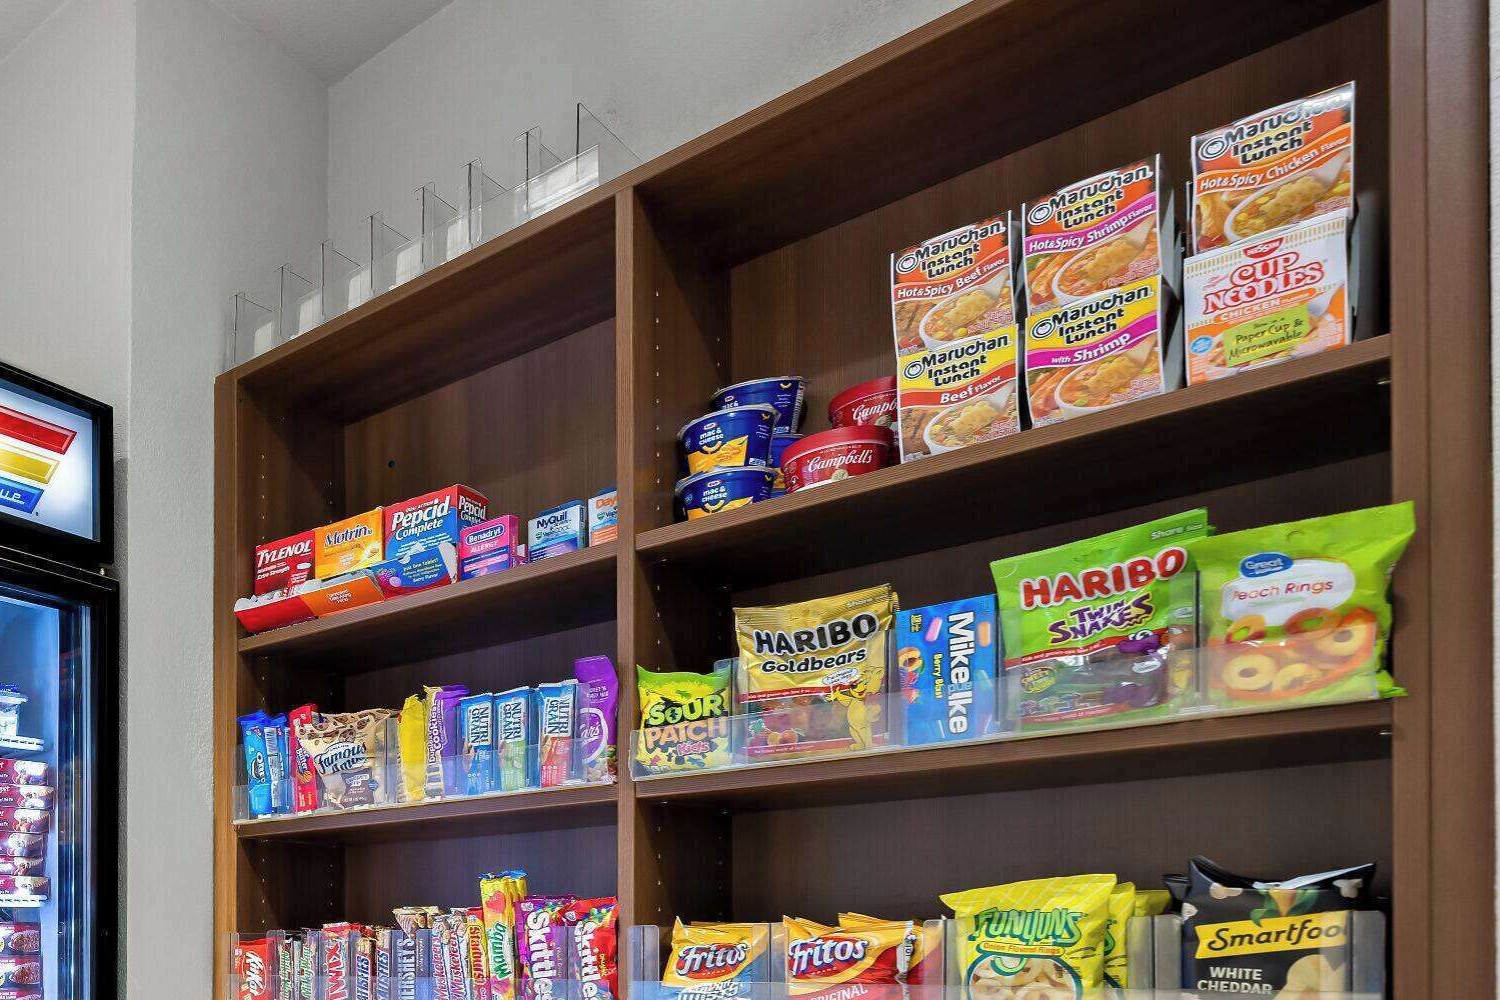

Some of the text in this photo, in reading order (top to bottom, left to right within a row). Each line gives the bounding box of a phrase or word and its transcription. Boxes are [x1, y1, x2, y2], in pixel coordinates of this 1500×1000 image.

[1231, 121, 1312, 155] Instant
[1240, 137, 1303, 165] Lunch
[1266, 148, 1319, 180] Chicken
[1049, 165, 1153, 210] Maruchan
[1056, 188, 1123, 222] Instant
[1063, 204, 1116, 229] Lunch
[915, 221, 1007, 260] Maruchan
[1087, 215, 1128, 243] Shrimp
[920, 244, 980, 271] Instant
[928, 257, 974, 279] Lunch
[1230, 251, 1300, 286] CUP
[956, 268, 981, 287] Beef
[1203, 261, 1325, 315] NOODLES
[1051, 285, 1153, 326] Maruchan
[1220, 298, 1281, 322] CHICKEN
[1052, 333, 1131, 364] with Shrimp
[1065, 322, 1117, 346] Lunch
[1228, 331, 1302, 361] Microwavable
[1235, 322, 1290, 345] Paper Cup
[921, 334, 1011, 368] Maruchan
[940, 385, 974, 404] Beef
[807, 449, 873, 473] Campbell's
[391, 496, 451, 531] Pepcid
[395, 517, 444, 541] Complete
[536, 511, 569, 530] NyQuil
[324, 524, 368, 547] Motrin
[468, 525, 502, 544] Benadryl
[257, 539, 314, 568] TYLENOL
[1019, 545, 1189, 611] HARIBO
[1284, 577, 1334, 597] Rings
[1048, 591, 1157, 645] SNAKES
[1069, 599, 1127, 626] TWIN
[754, 612, 879, 656] HARIBO
[761, 648, 867, 674] Goldbears
[948, 611, 975, 735] Mike Ike
[471, 708, 480, 744] GRAIN
[480, 706, 490, 745] NUTRI
[503, 704, 512, 741] GRAIN
[512, 701, 522, 740] NUTRI
[646, 694, 724, 727] SOUR
[644, 715, 727, 749] PATCH
[315, 741, 367, 773] Famous
[972, 906, 1083, 948] FUNYUNS
[677, 941, 750, 976] Fritos
[788, 936, 869, 977] Fritos
[1196, 978, 1273, 996] CHEDDAR
[1208, 965, 1263, 981] WHITE
